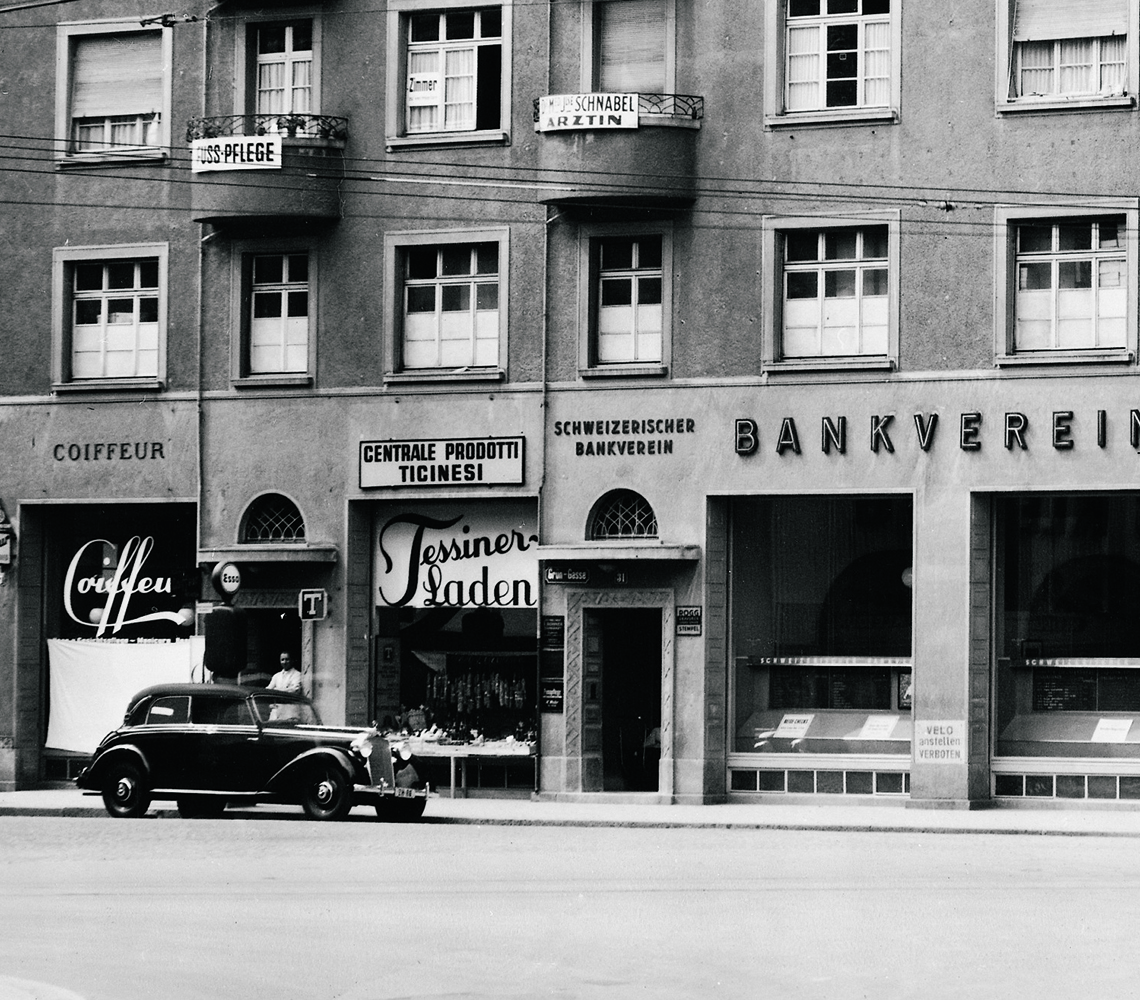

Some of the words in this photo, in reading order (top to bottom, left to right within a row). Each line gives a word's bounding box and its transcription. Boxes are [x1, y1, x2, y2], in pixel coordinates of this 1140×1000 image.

[574, 95, 635, 113] SCHNABEL
[554, 418, 695, 436] SCHWEIZERISCHER
[53, 441, 166, 461] COIFFEUR
[363, 441, 436, 463] CENTRALE
[445, 440, 519, 461] PRODOTTI
[575, 439, 673, 457] BANKVEREIN
[398, 463, 483, 483] TICINESI
[222, 573, 239, 583] Esso
[422, 563, 538, 607] Laden
[304, 593, 322, 615] T
[926, 726, 953, 735] VELO
[919, 736, 961, 746] anstellen
[919, 749, 961, 759] VERBOTEN
